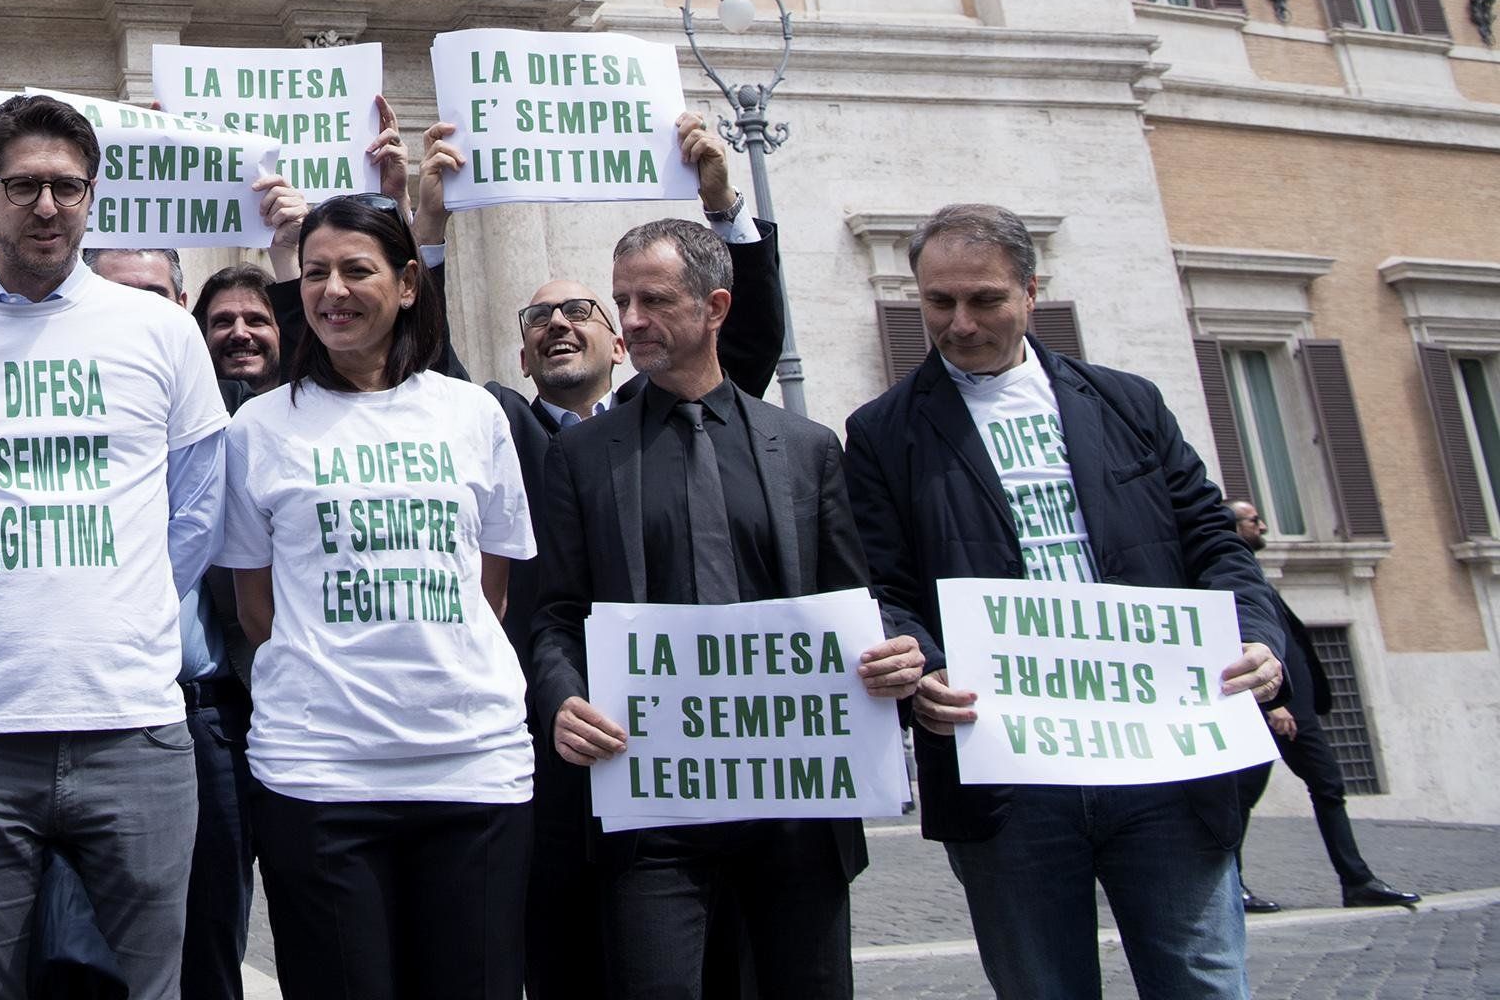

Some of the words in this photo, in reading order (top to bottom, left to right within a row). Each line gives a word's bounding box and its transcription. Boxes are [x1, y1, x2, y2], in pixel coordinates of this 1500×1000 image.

[184, 67, 222, 97] LA
[237, 67, 348, 100] DIFESA
[471, 51, 513, 84] LA
[527, 53, 647, 86] DIFESA
[84, 104, 104, 128] A
[471, 98, 498, 133] E'
[515, 99, 654, 134] SEMPRE
[105, 144, 244, 182] SEMPRE
[472, 148, 659, 184] LEGITTIMA
[85, 197, 243, 234] GITTIMA
[4, 358, 107, 418] DIFESA
[312, 447, 350, 486] LA
[355, 441, 458, 485] DIFESA
[987, 414, 1071, 471] DIFES
[316, 500, 340, 554] E'
[349, 498, 459, 554] SEMPRE
[1004, 479, 1077, 538] SEMP
[323, 568, 463, 624] LEGITTIMA
[982, 595, 1203, 647] LEGITTIMA
[628, 632, 677, 676] LA
[696, 631, 845, 676] DIFESA
[991, 653, 1157, 705] SEMPRE
[627, 695, 660, 737] E'
[681, 692, 851, 738] SEMPRE
[1000, 713, 1154, 759] DIFESA
[1166, 721, 1228, 756] LA
[628, 756, 857, 800] LEGITTIMA
